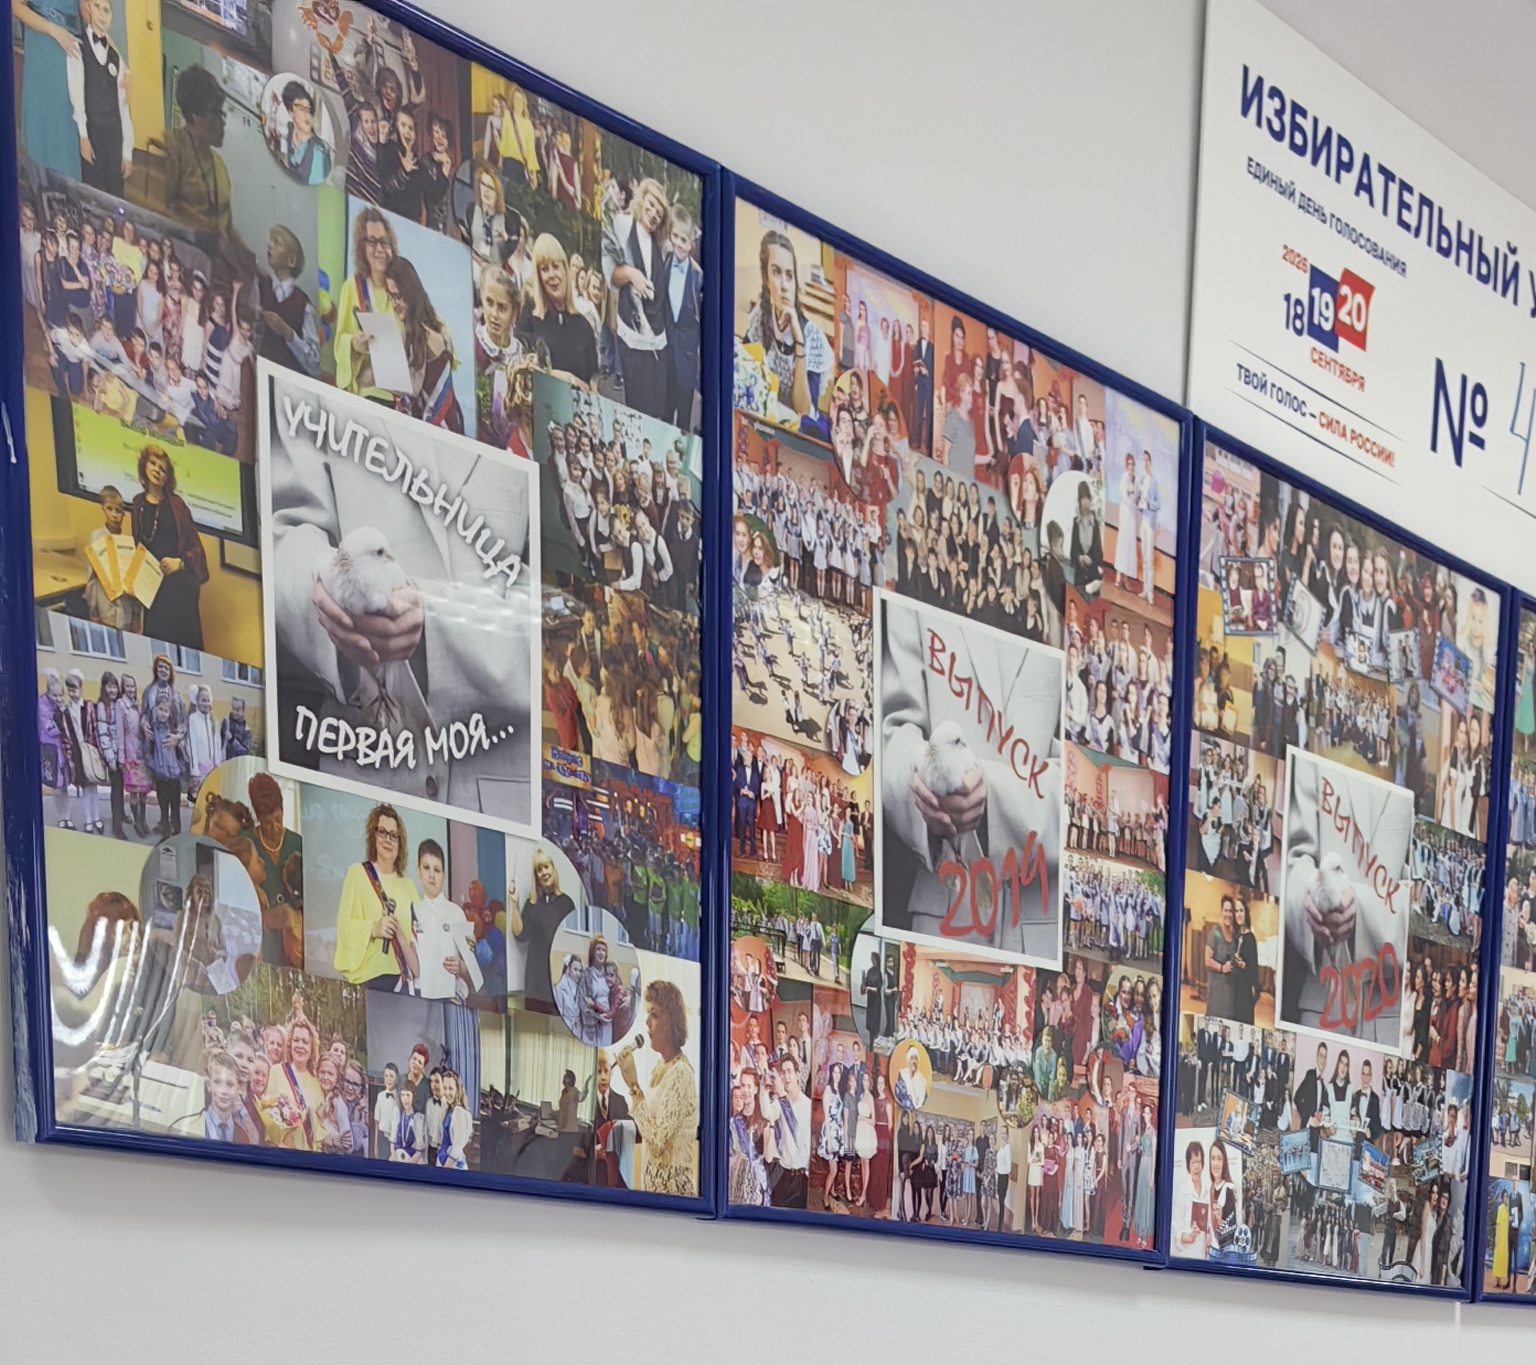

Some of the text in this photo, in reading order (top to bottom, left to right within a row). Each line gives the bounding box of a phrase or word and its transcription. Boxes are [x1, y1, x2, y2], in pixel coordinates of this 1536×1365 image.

[1241, 64, 1520, 306] ИЗБИРАТЕЛЬНЫЙ
[1247, 156, 1407, 278] ЕДИНЫЙ ДЕНЬ ГОЛОСОВАНИЯ
[1284, 284, 1367, 337] 18 19 20
[1237, 363, 1268, 395] ТВОЙ
[1270, 383, 1307, 417] ГОЛОС
[1318, 411, 1347, 443] СИЛА
[1311, 347, 1365, 392] СЕНТЯБРЯ
[1430, 357, 1489, 468] №
[283, 397, 521, 588] УЧИТЕЛЬНИЦА
[296, 705, 416, 769] ПЕРВАЯ
[424, 713, 514, 767] МОЯ...
[927, 628, 1048, 799] ВЫПУСК
[1321, 776, 1399, 914] ВЫПУСК
[1319, 942, 1399, 1029] 2020
